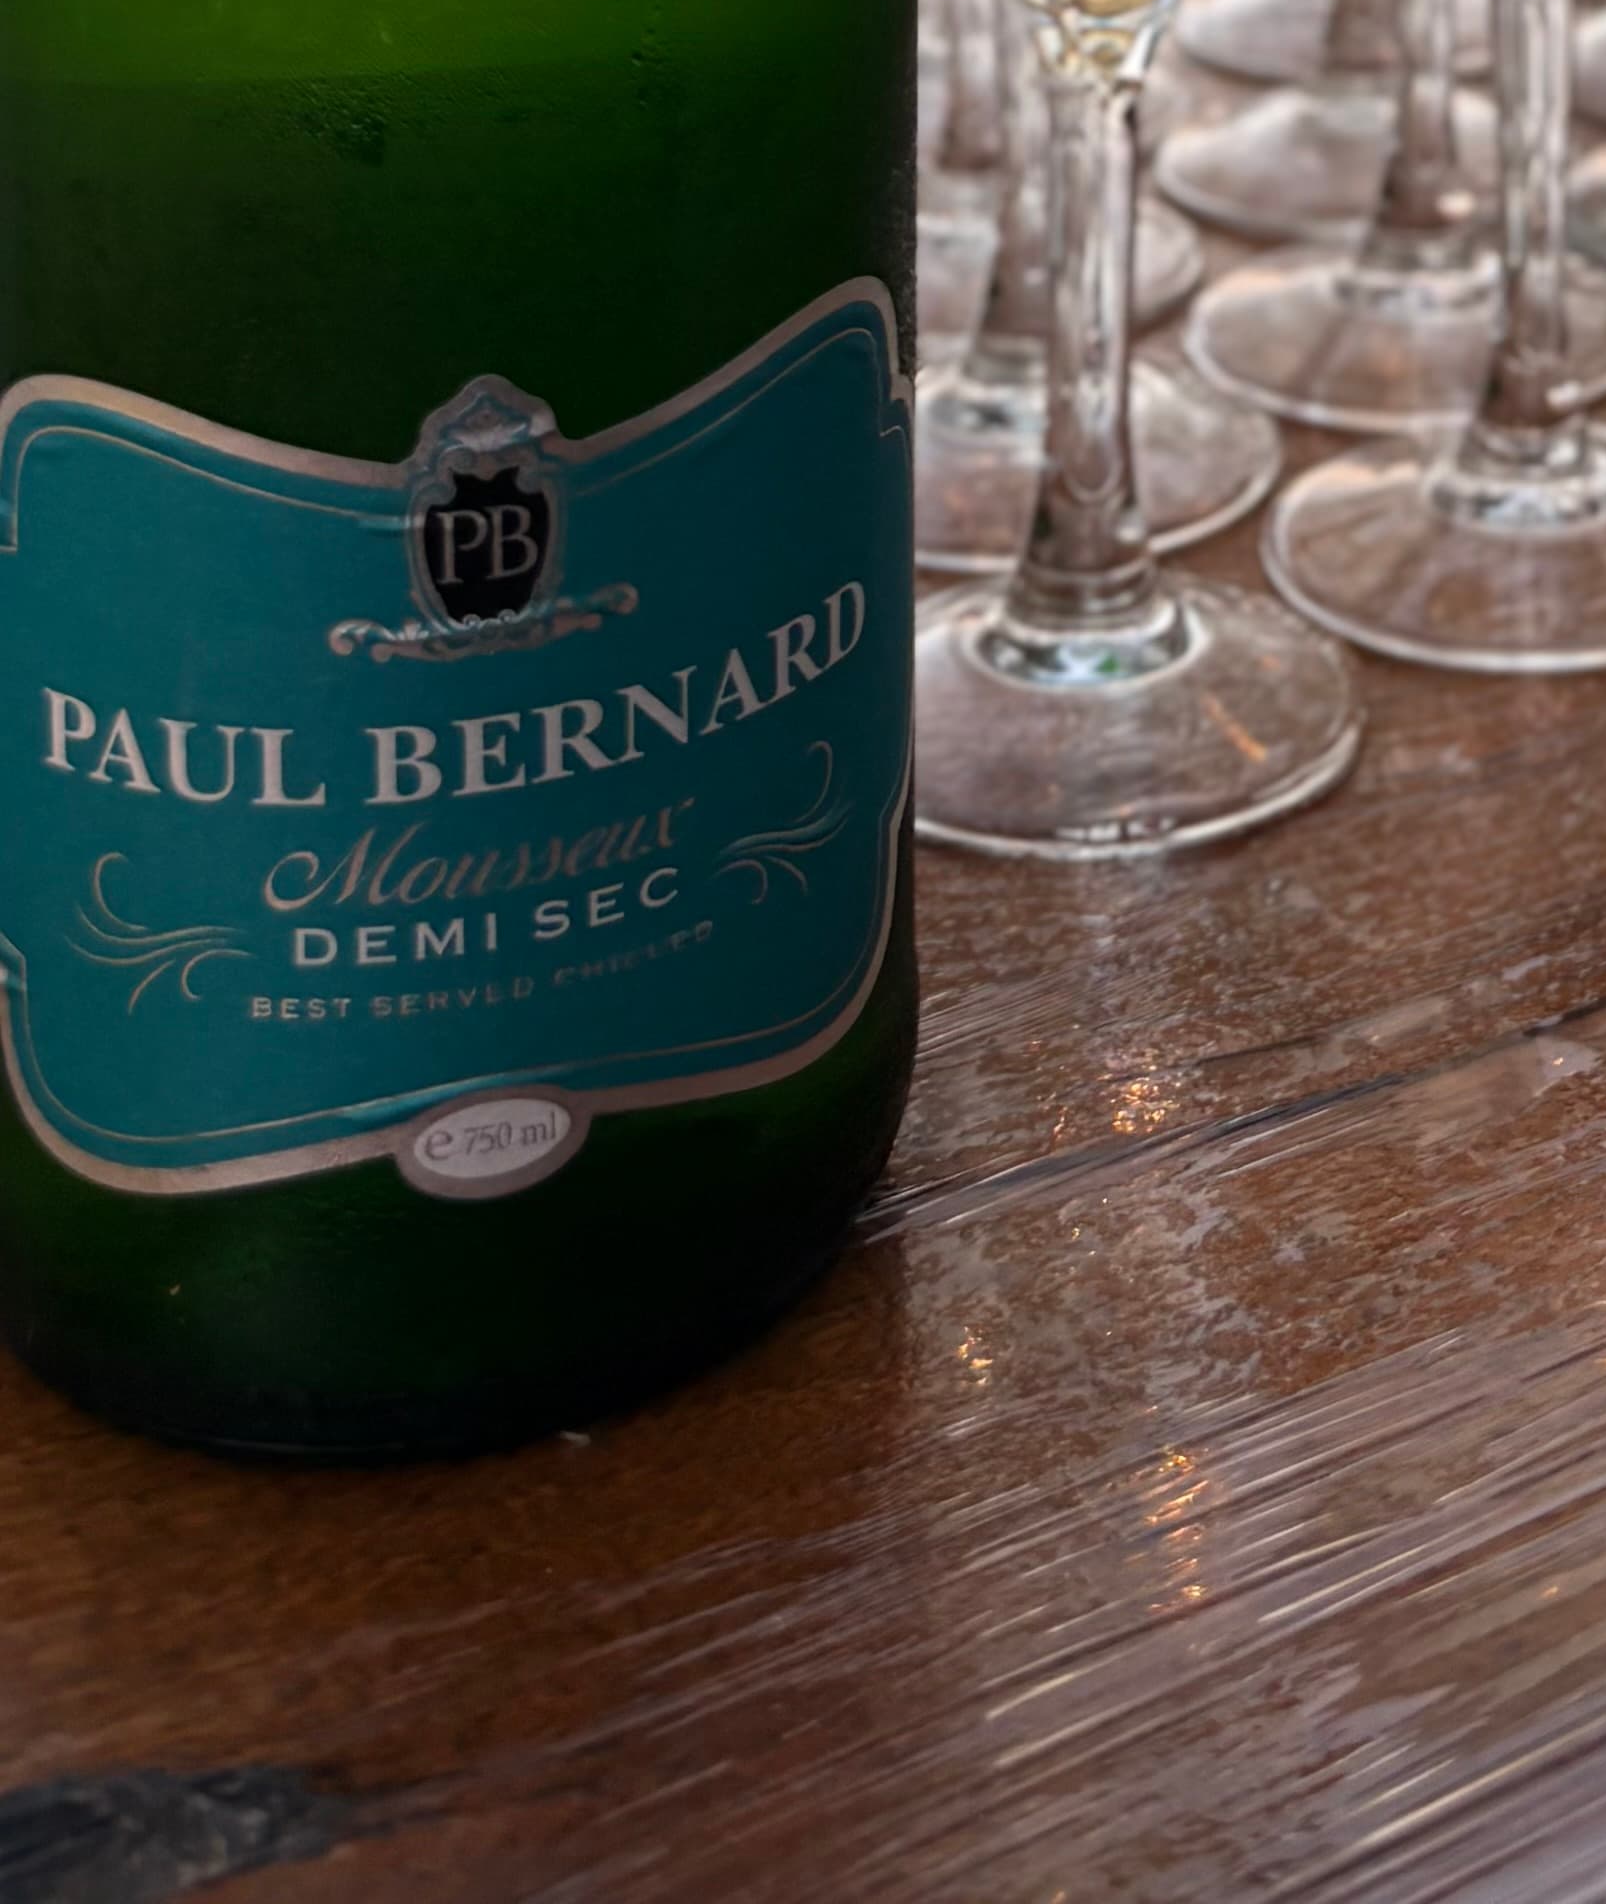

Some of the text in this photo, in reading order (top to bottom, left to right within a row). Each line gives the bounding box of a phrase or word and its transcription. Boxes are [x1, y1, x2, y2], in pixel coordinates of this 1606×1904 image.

[434, 503, 539, 586] PB
[43, 580, 868, 807] PAUL BERNARD
[263, 796, 696, 911] Mousseux
[292, 866, 679, 967] DEMI SEC
[251, 996, 351, 1020] BEST
[463, 1121, 513, 1155] 750
[521, 1111, 556, 1147] ml
